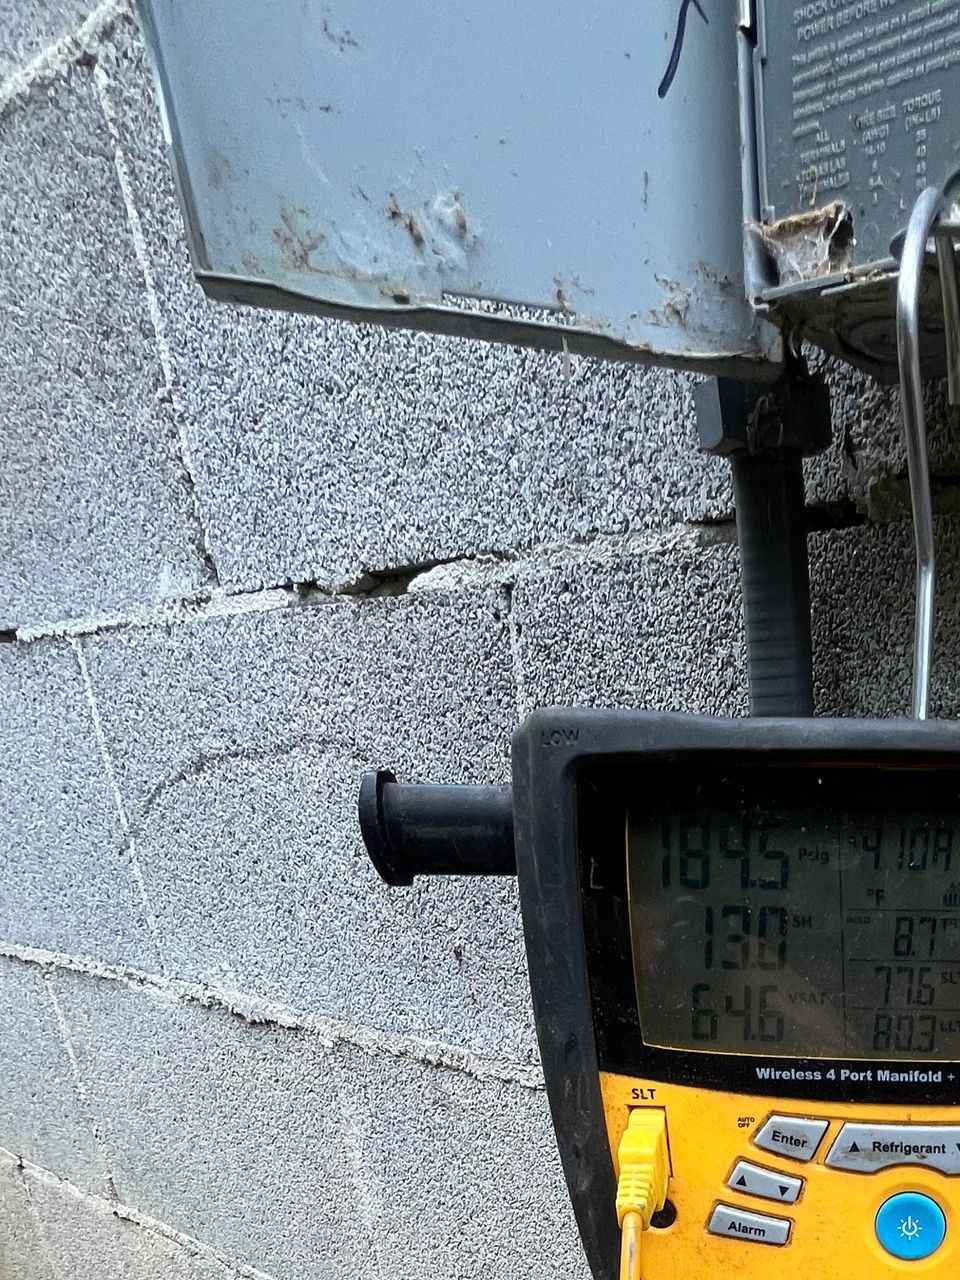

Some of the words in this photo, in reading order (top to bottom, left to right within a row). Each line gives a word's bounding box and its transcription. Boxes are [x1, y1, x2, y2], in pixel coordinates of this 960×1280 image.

[540, 729, 579, 746] LOW
[792, 915, 812, 928] SH
[755, 1067, 822, 1081] Wireless
[826, 1068, 836, 1081] 4
[841, 1069, 873, 1082] Port
[877, 1070, 942, 1083] Manifold
[947, 1073, 955, 1081] +
[631, 1088, 657, 1100] SLT
[771, 1130, 808, 1149] Enter
[872, 1141, 946, 1158] Refrigerant
[728, 1221, 766, 1238] Alarm
